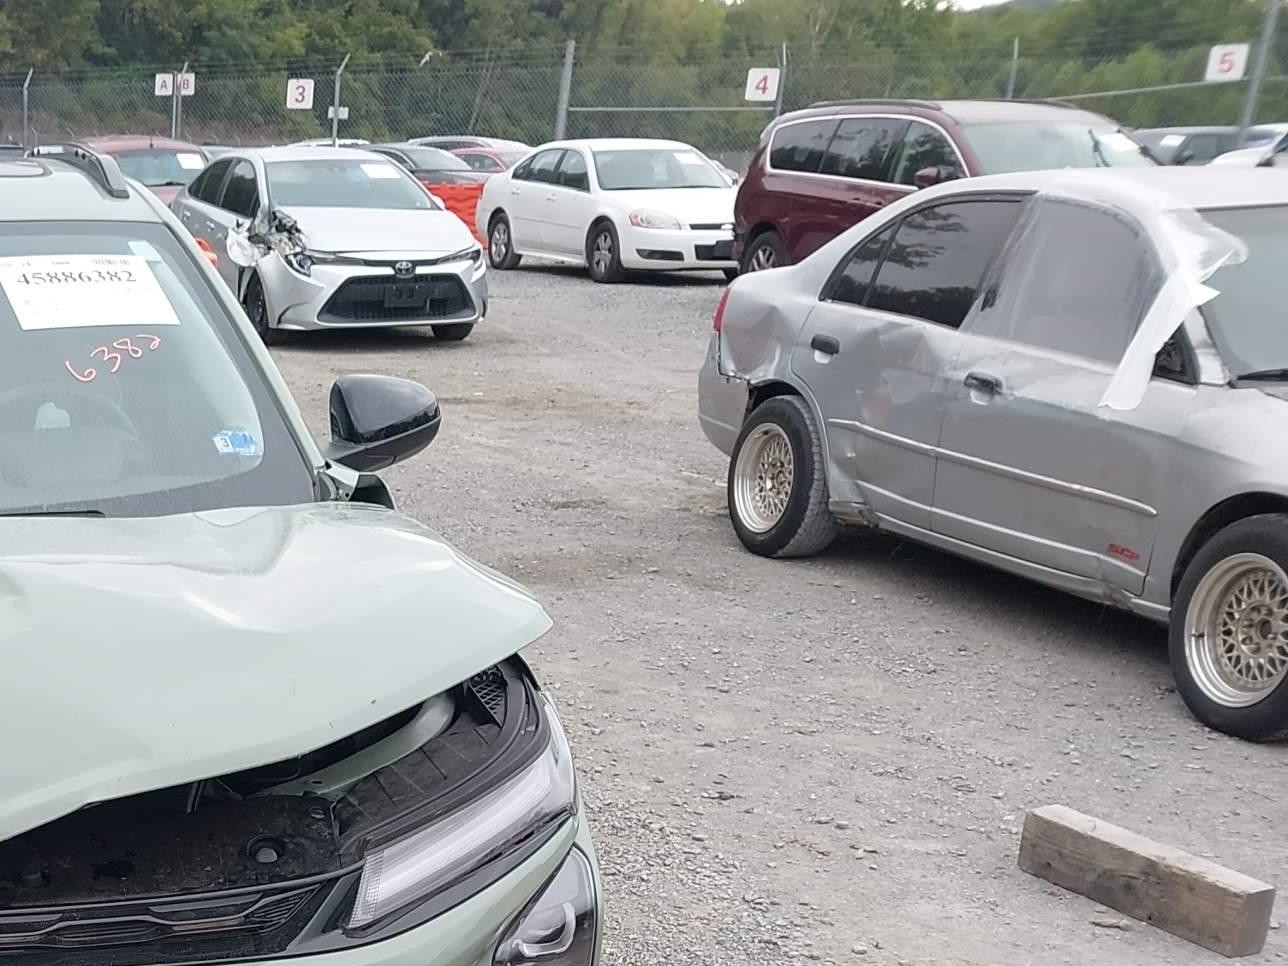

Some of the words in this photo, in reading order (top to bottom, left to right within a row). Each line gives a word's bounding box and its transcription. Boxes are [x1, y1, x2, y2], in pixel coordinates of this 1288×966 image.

[1218, 51, 1236, 74] 5
[160, 79, 168, 90] A
[182, 79, 190, 90] B
[755, 75, 769, 94] 4
[295, 85, 306, 103] 3
[16, 270, 137, 286] 45886382
[64, 333, 162, 382] 6382
[220, 437, 230, 448] 3
